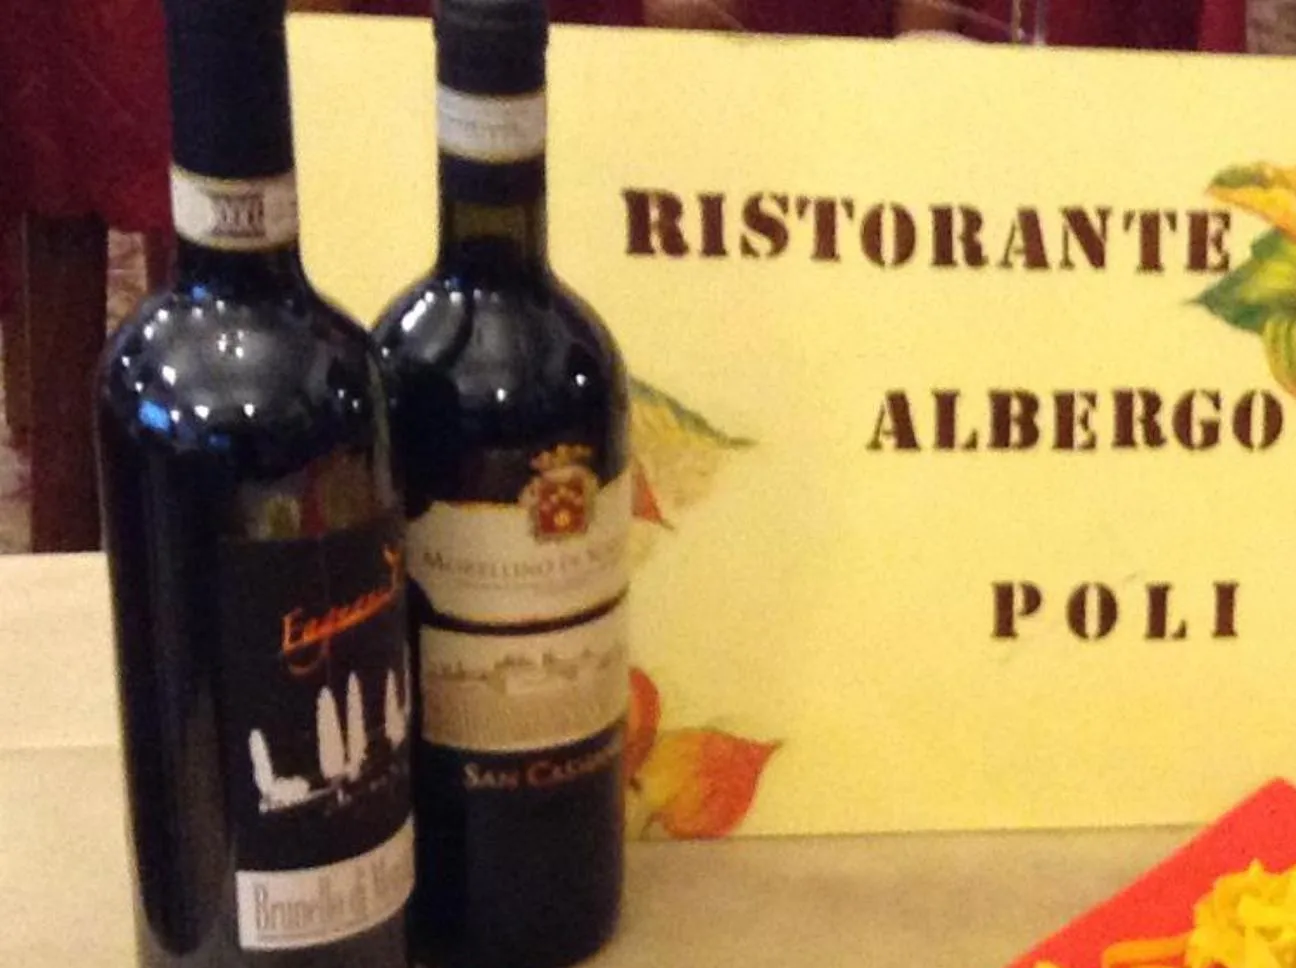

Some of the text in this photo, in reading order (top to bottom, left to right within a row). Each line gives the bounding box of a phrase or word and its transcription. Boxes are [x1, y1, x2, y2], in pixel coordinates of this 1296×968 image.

[621, 188, 1232, 273] RISTORANTE
[869, 388, 1285, 451] ALBERGO
[993, 582, 1239, 640] POLI
